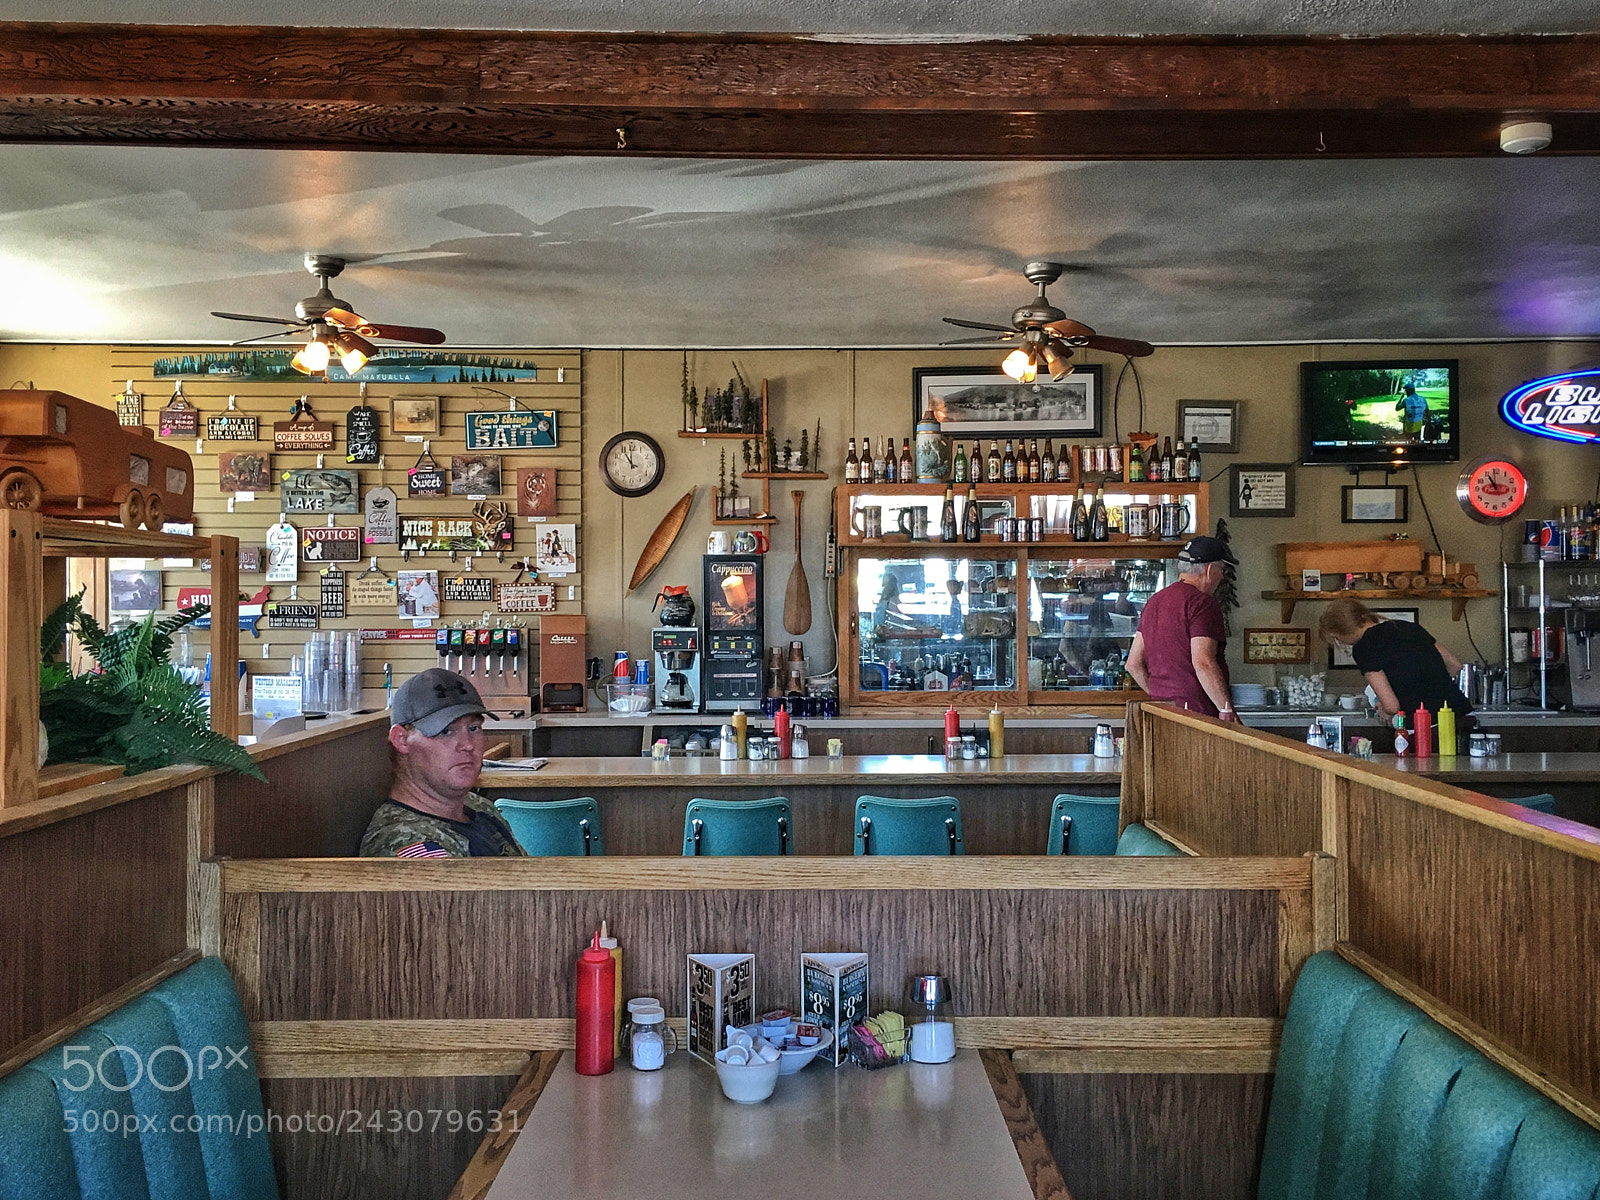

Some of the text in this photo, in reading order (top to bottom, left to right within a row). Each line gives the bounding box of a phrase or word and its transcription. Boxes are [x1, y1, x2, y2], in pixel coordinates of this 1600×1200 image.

[1522, 403, 1600, 424] LIG
[475, 414, 532, 427] Good things
[475, 428, 538, 447] BAIT
[349, 444, 376, 459] Coffee
[296, 474, 312, 488] Life
[411, 475, 442, 488] Sweet
[287, 497, 324, 510] LAKE
[306, 530, 356, 540] NOTICE
[403, 521, 472, 536] NICE RACK
[712, 564, 752, 575] Cappuccino
[322, 592, 342, 604] BEER
[506, 600, 536, 608] COFFEE
[280, 606, 316, 615] FRIEND
[732, 995, 751, 1014] BEST
[733, 1006, 750, 1028] DAMN
